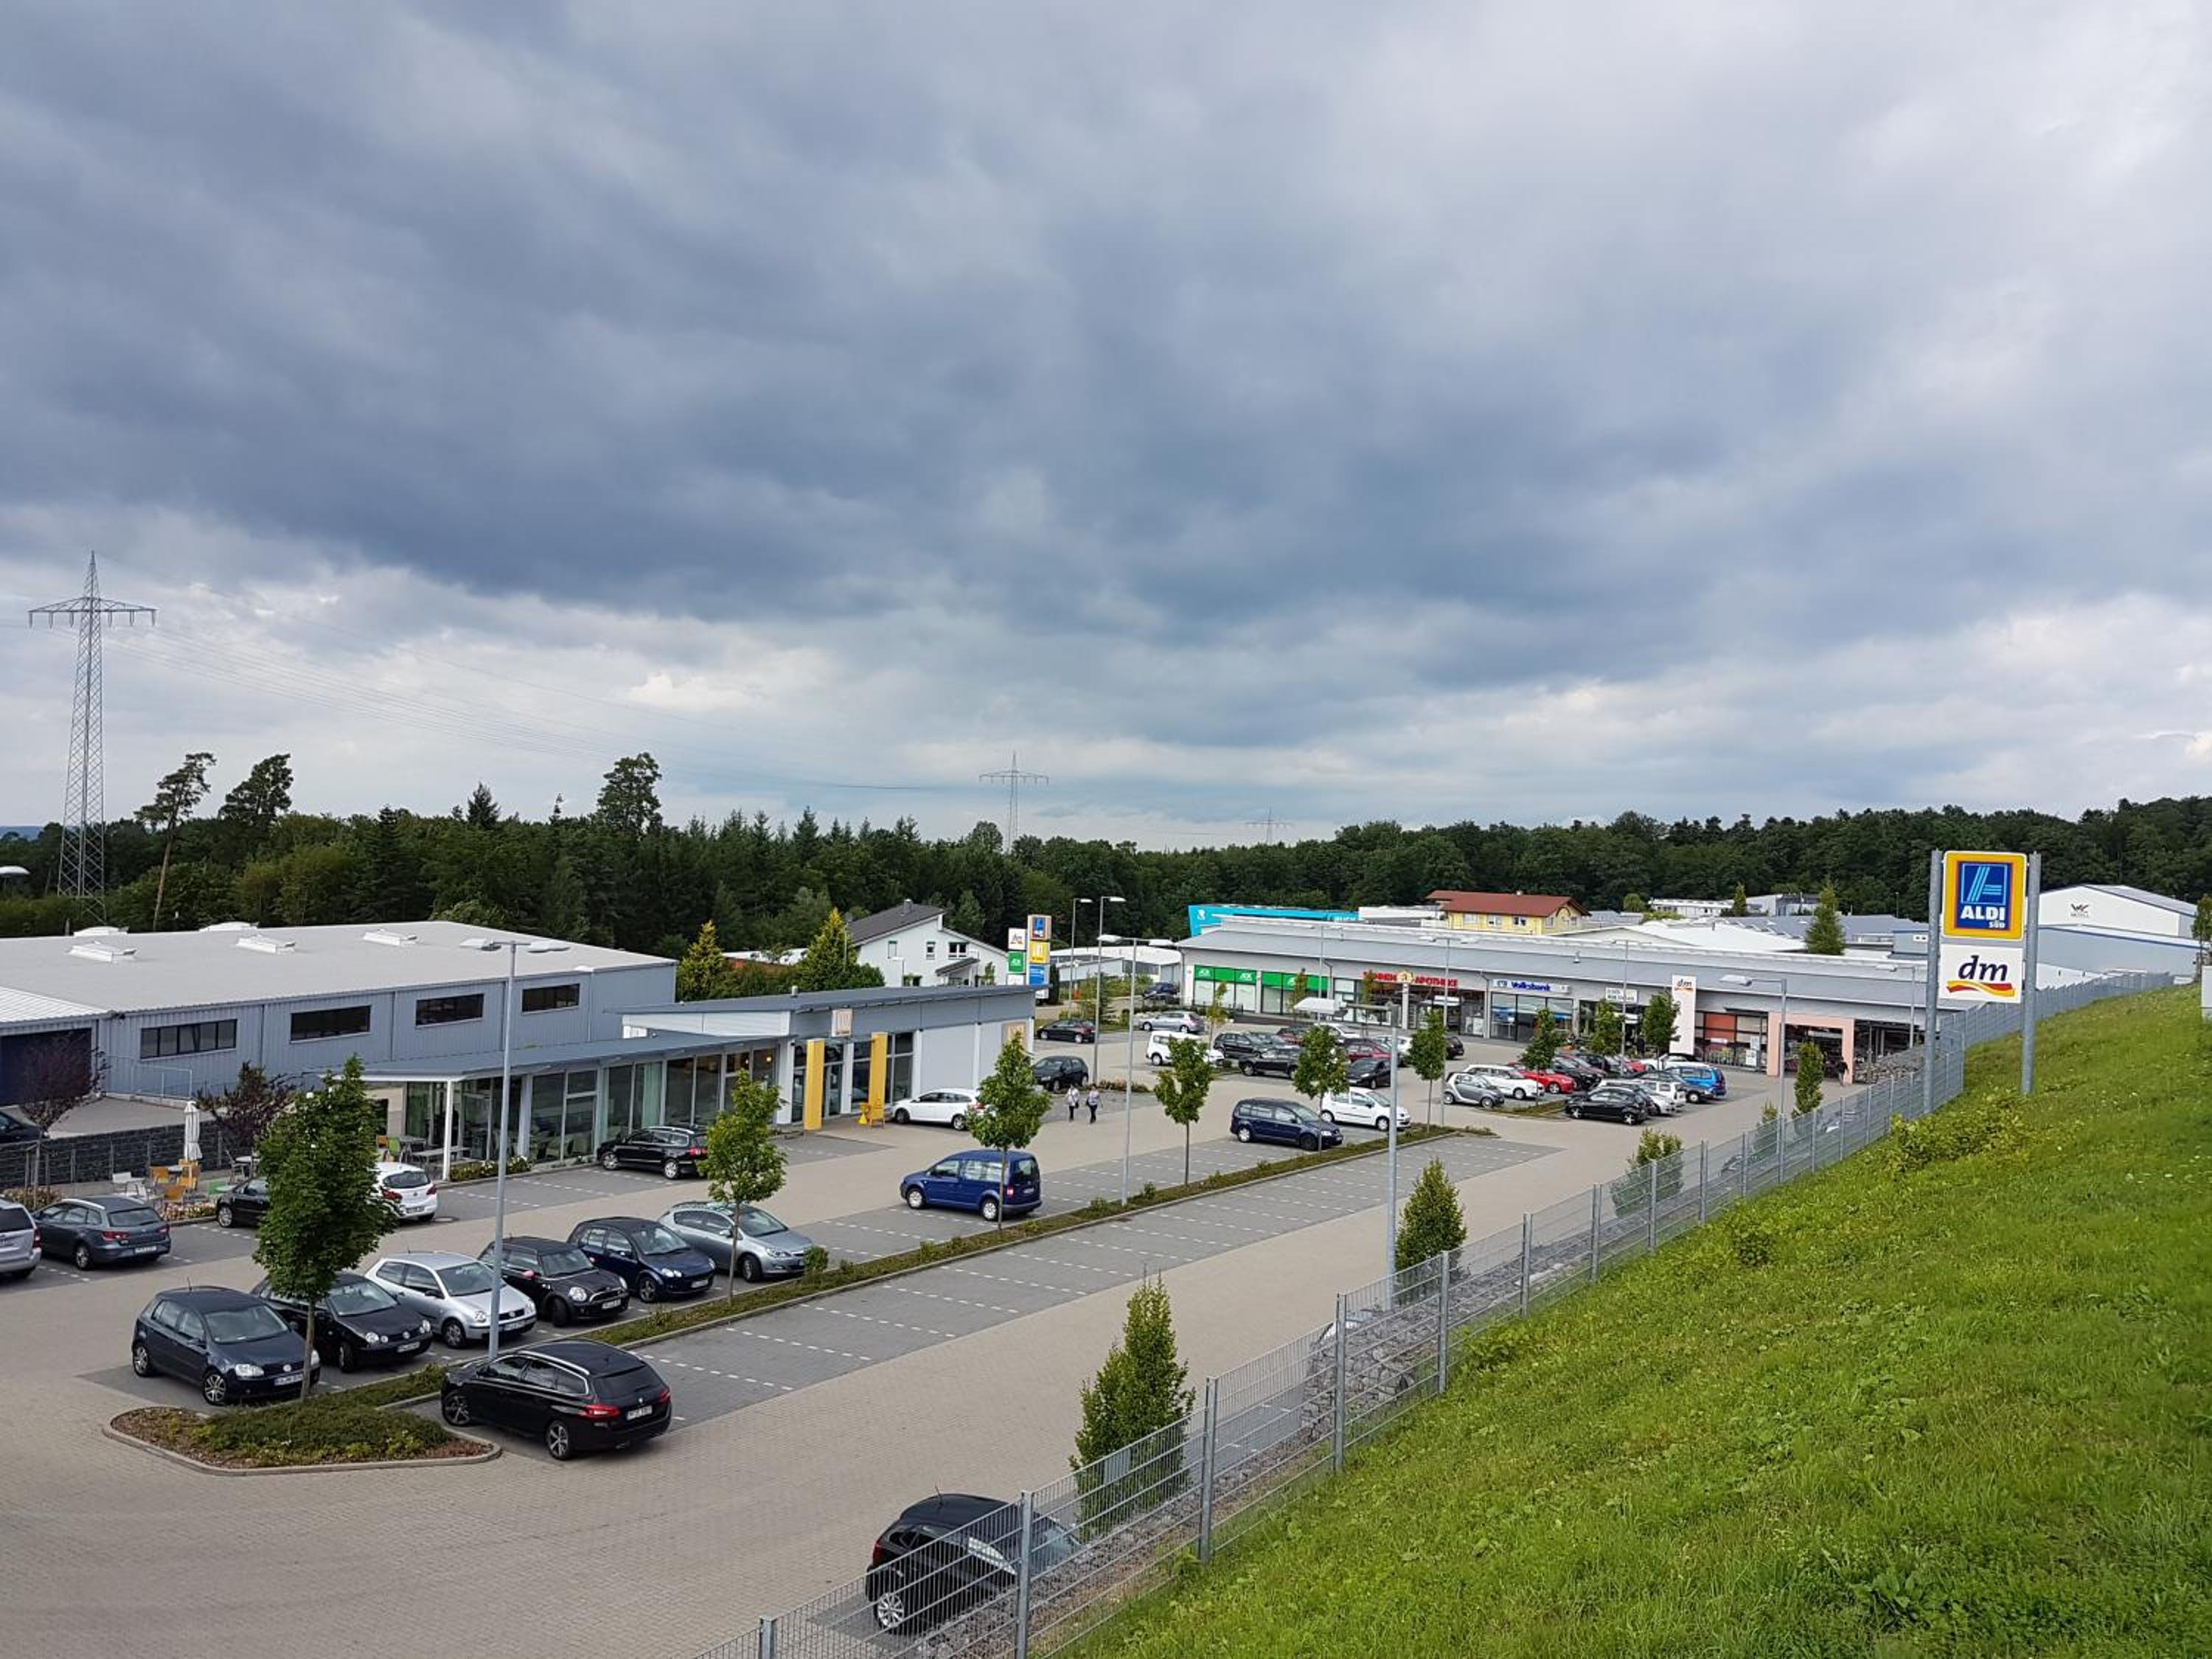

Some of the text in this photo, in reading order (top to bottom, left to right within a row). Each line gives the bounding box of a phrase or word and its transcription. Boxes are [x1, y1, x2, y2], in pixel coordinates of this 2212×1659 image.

[1960, 905, 2006, 920] ALDI
[1958, 954, 2008, 981] dm
[1511, 981, 1551, 992] Volksbank
